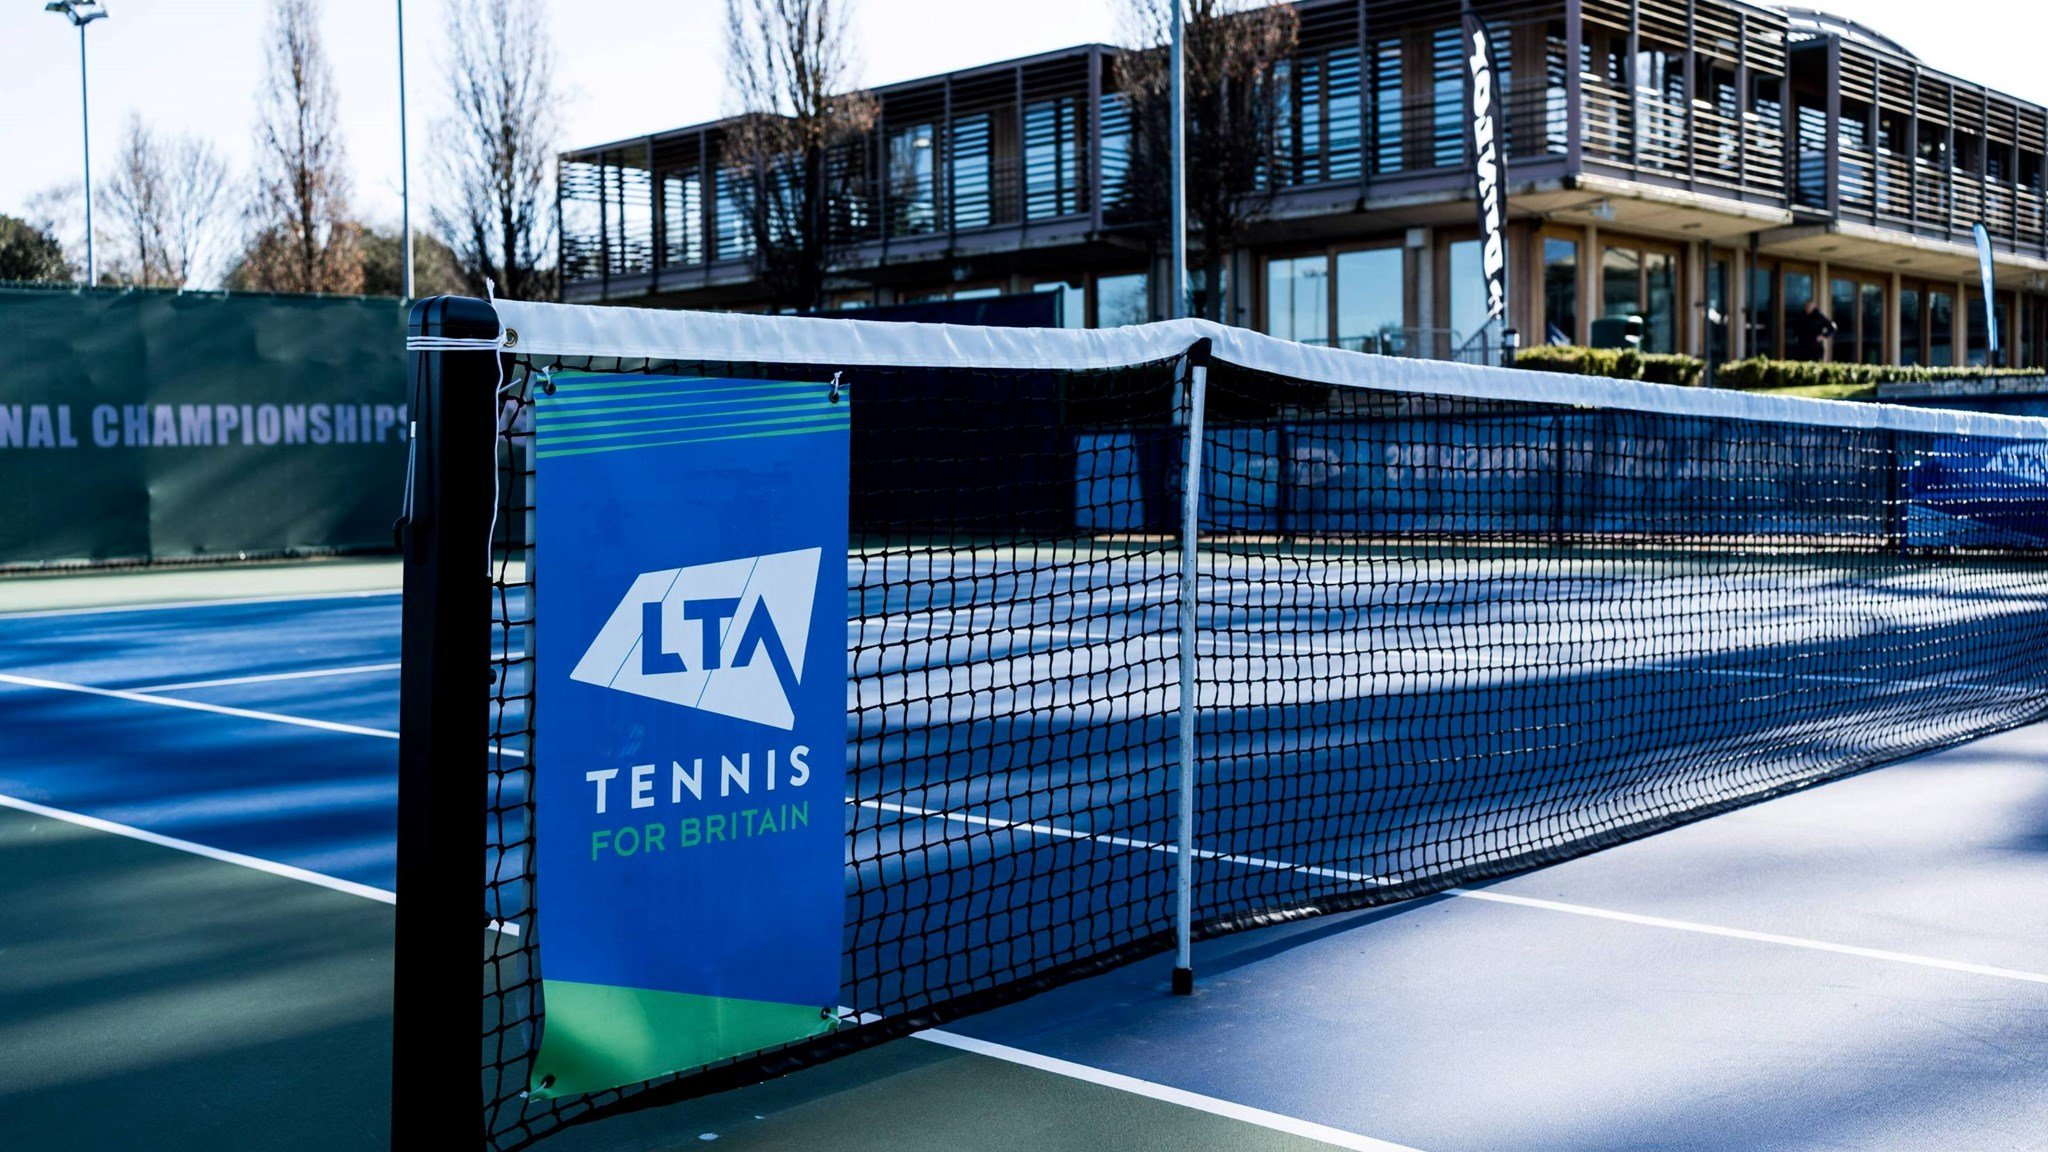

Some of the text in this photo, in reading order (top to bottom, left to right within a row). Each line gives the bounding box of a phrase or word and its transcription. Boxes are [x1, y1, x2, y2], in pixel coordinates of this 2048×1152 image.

[642, 595, 802, 686] LTA
[586, 745, 810, 814] TENNIS
[592, 801, 808, 861] FOR BRITAIN
